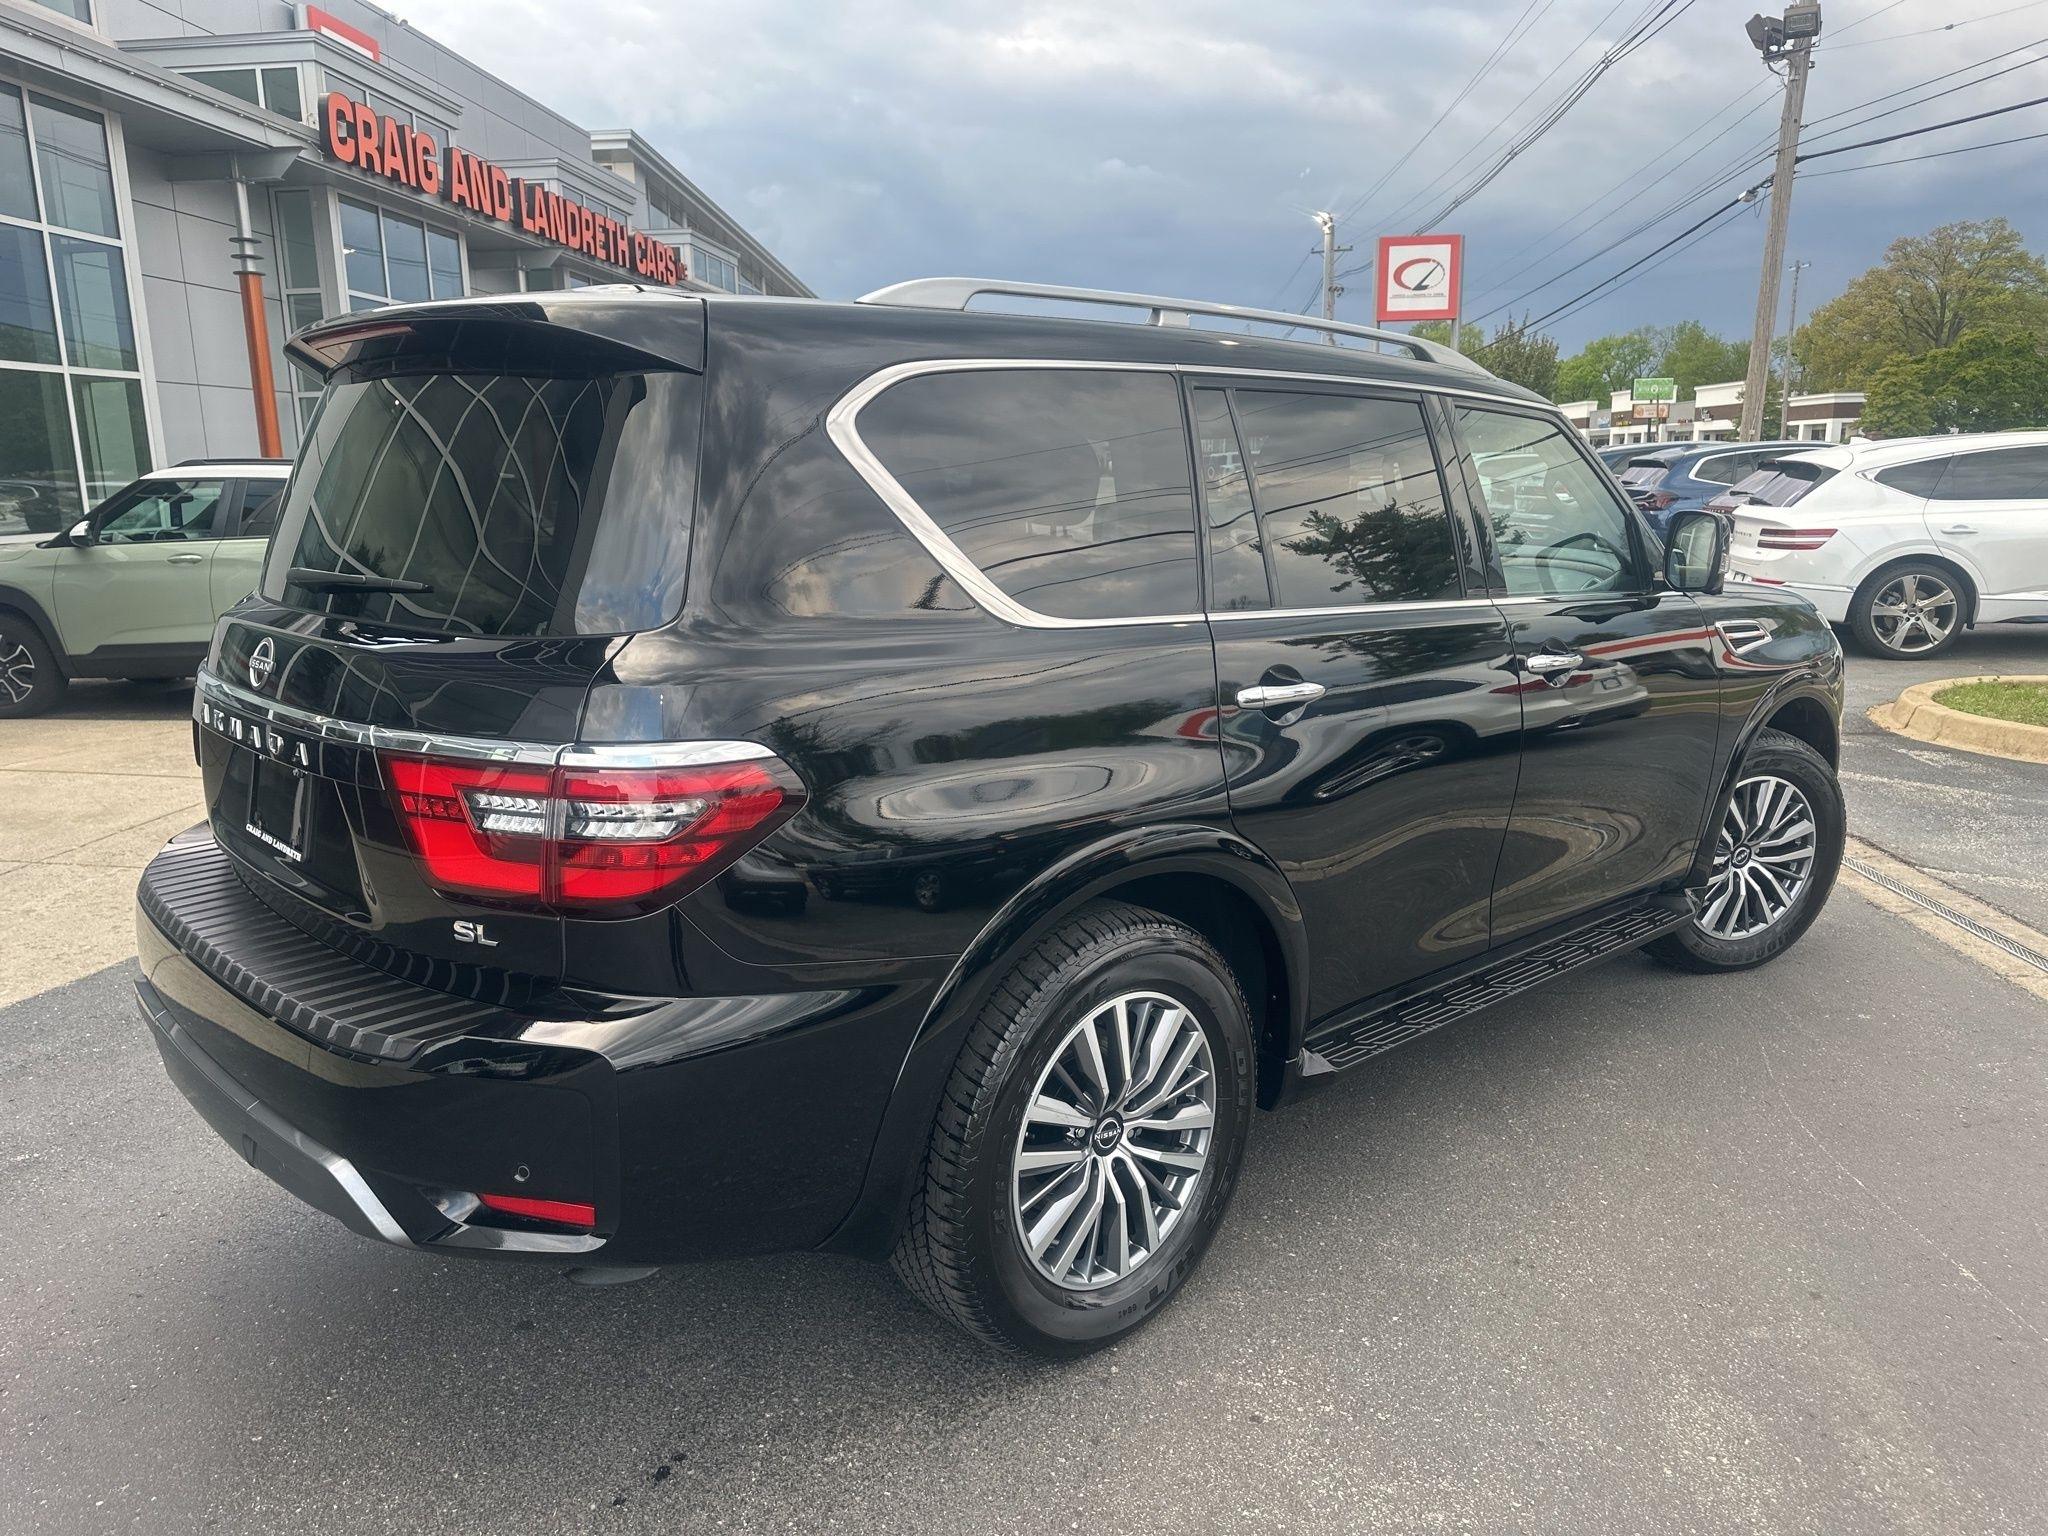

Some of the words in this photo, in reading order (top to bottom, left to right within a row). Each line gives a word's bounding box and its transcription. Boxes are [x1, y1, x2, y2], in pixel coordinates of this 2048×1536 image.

[325, 91, 439, 195] CRAIG
[450, 146, 511, 222] AND
[518, 177, 631, 268] LANDRETH
[634, 230, 677, 286] CARS
[245, 823, 262, 838] CRAIG
[261, 832, 273, 845] AND
[453, 920, 499, 947] SL
[1094, 1127, 1122, 1141] NISSAN
